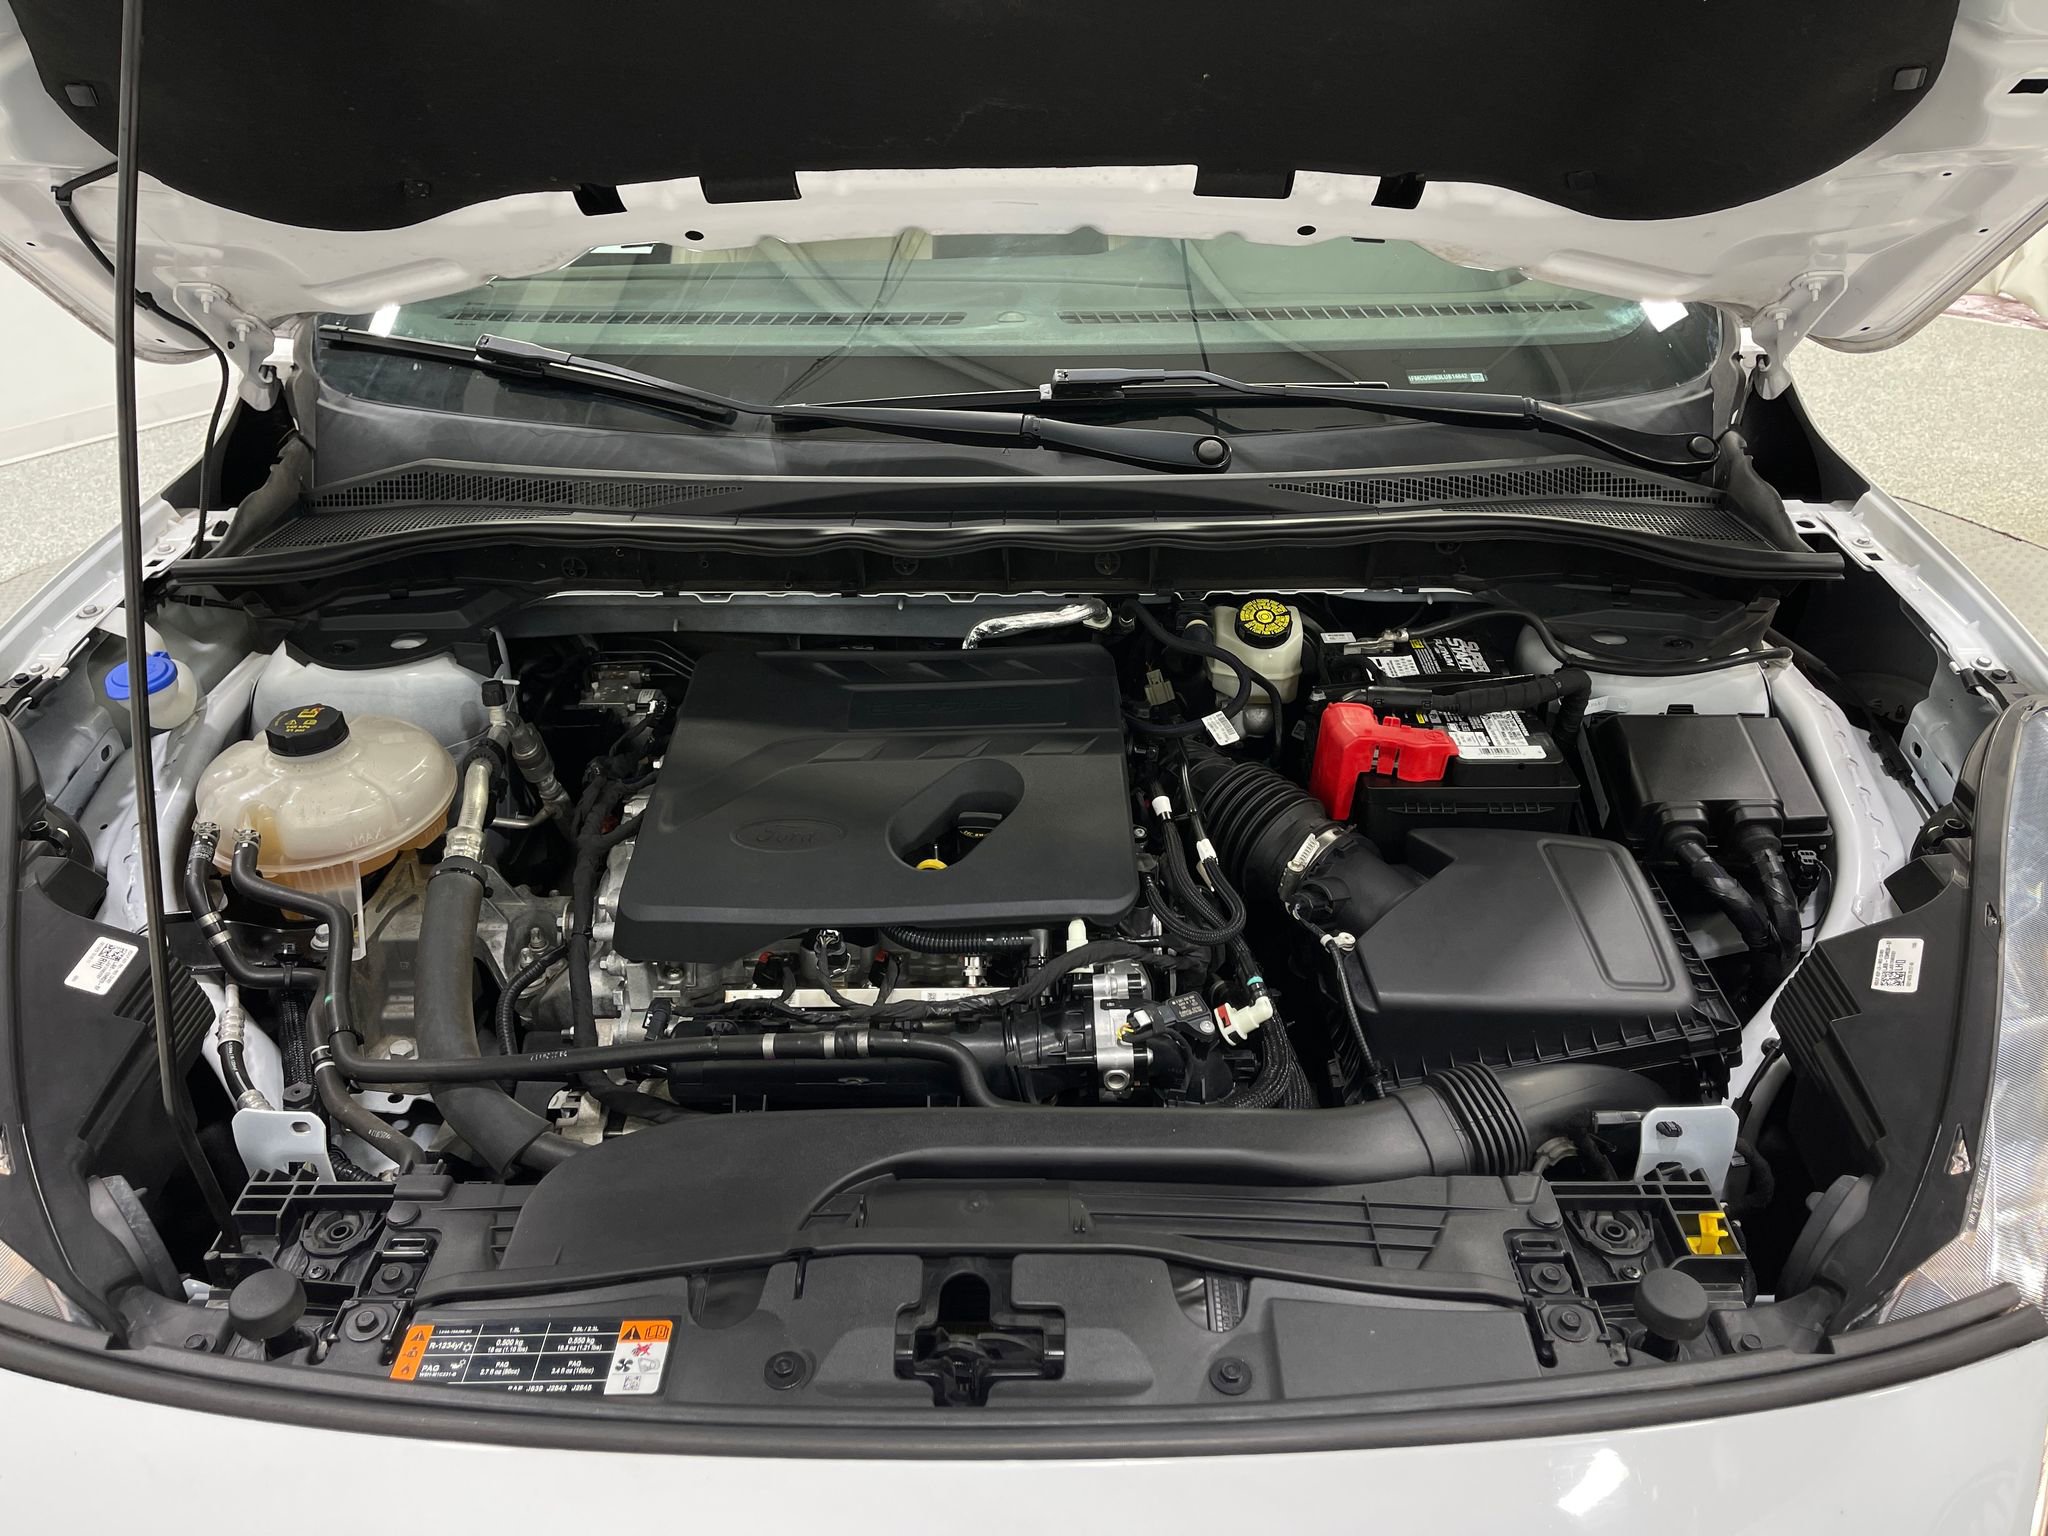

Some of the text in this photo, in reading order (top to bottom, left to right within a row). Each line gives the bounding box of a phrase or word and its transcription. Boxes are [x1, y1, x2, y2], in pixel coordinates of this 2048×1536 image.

[1445, 637, 1479, 673] START
[1467, 641, 1491, 673] SUPER
[496, 1338, 524, 1347] 0.500 kg
[586, 1336, 595, 1345] kg
[429, 1341, 464, 1351] R-1234yf
[421, 1364, 440, 1372] PAG
[495, 1361, 510, 1369] PAG
